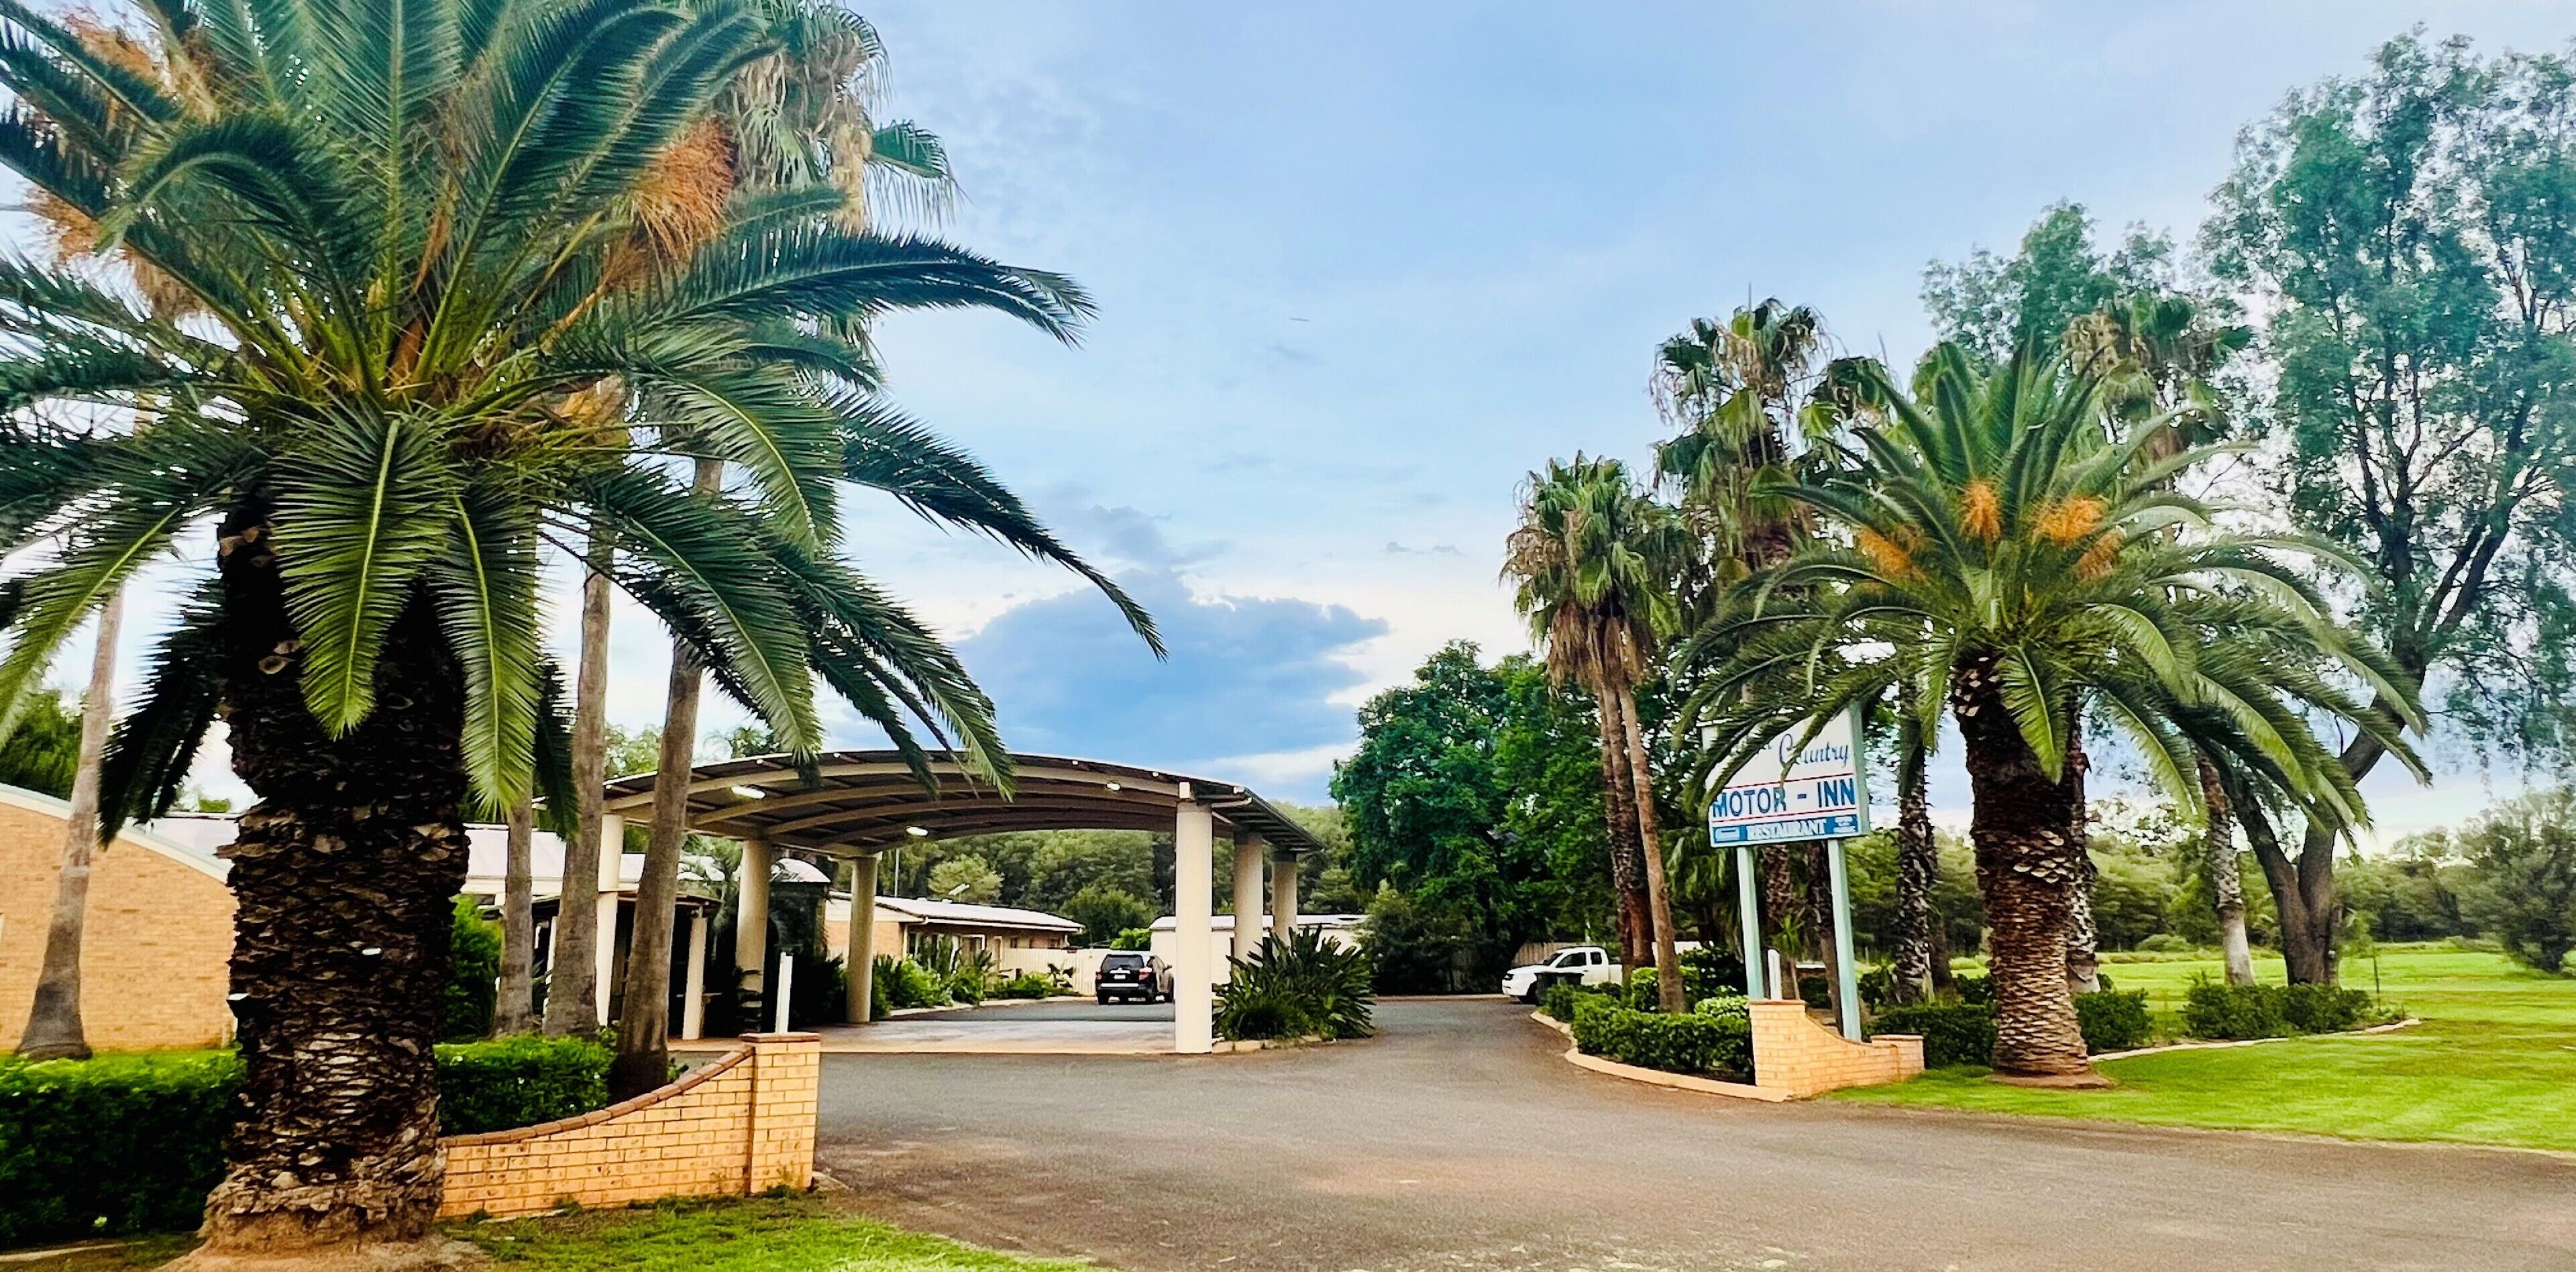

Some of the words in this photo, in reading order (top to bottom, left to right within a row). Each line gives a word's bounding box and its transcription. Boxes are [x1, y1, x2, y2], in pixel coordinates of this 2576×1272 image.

[1779, 733, 1848, 768] Cuntry
[1713, 786, 1786, 817] MOTOR
[1817, 778, 1856, 808] INN
[1746, 818, 1827, 840] RESTAURANT
